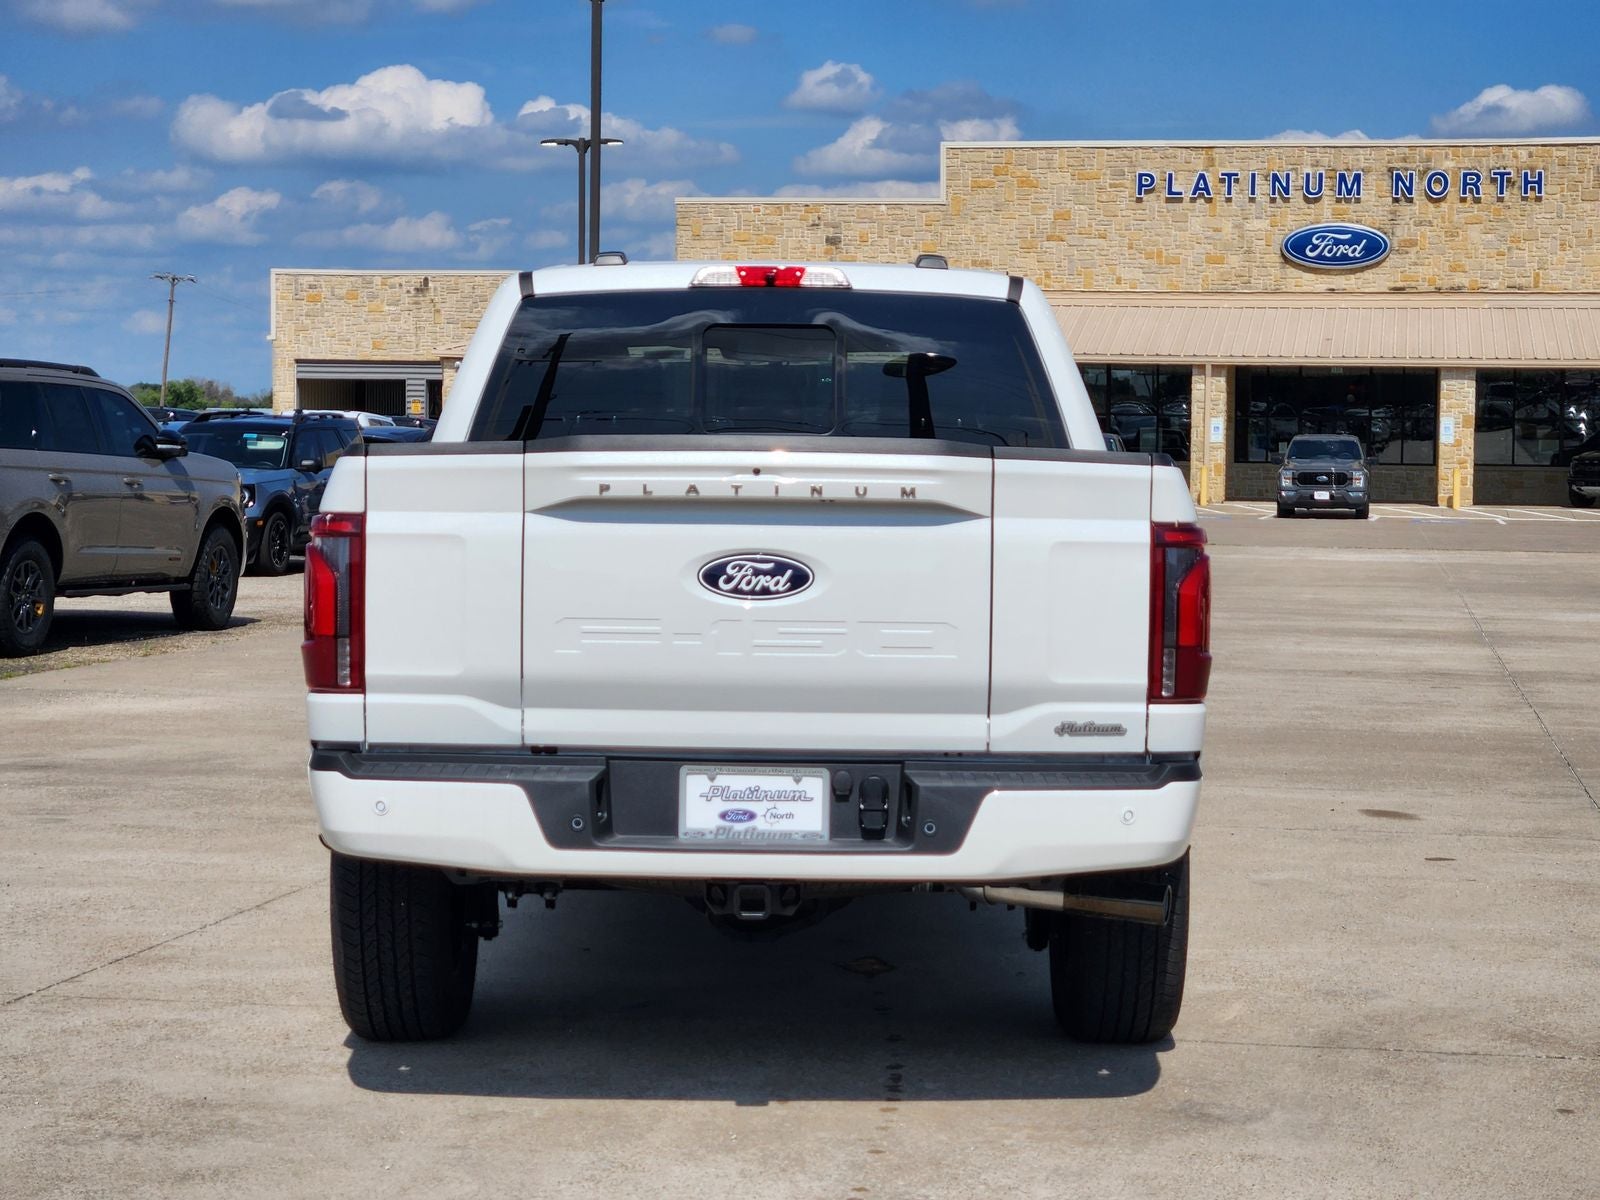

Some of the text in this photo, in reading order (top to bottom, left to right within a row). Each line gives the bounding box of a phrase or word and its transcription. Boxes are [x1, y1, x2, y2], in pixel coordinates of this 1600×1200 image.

[1136, 168, 1546, 199] PLATINUM NORTH
[1305, 231, 1367, 259] Ford
[598, 482, 917, 500] PLATINUM
[717, 559, 794, 593] Ford
[554, 616, 959, 660] F-150
[1054, 720, 1128, 737] Platinum
[699, 785, 814, 802] Platinum
[769, 810, 795, 821] North
[711, 826, 798, 841] Platinum
